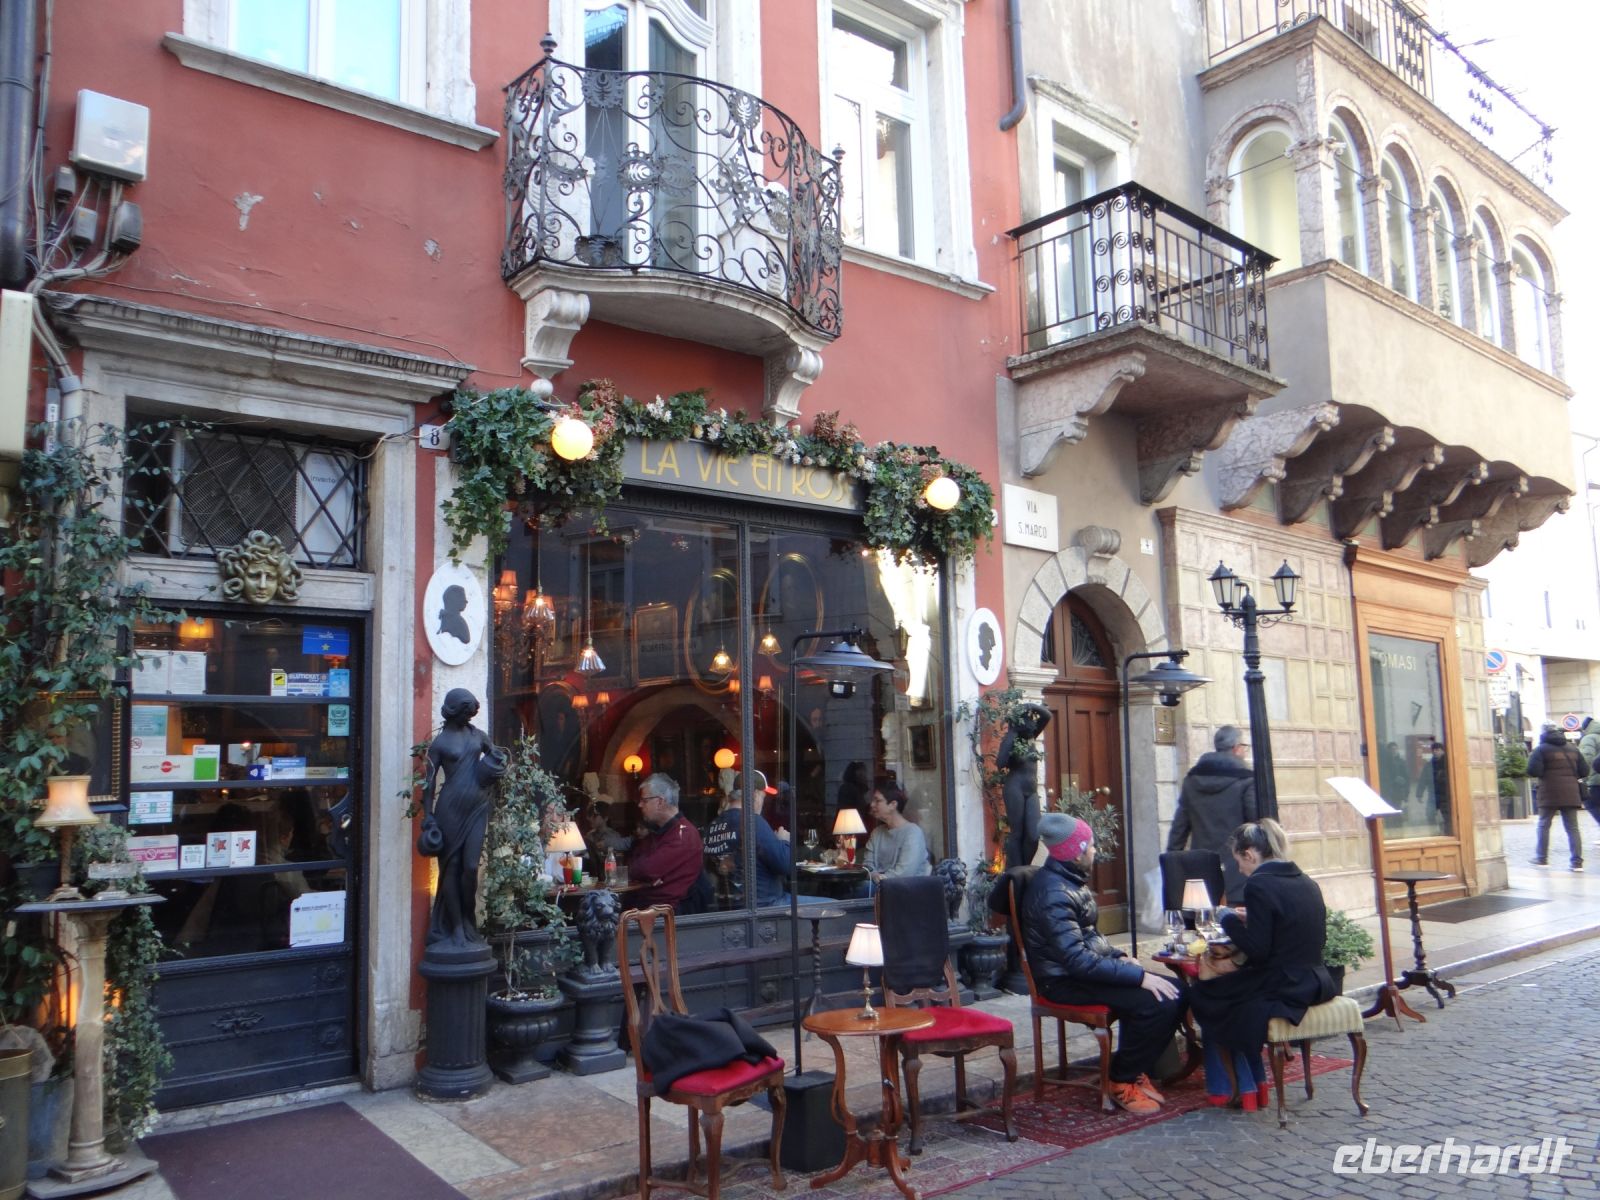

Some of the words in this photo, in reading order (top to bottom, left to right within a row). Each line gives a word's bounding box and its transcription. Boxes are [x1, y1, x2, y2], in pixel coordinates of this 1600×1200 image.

[431, 427, 440, 446] 8
[641, 438, 681, 478] LA
[1026, 500, 1038, 513] VIA
[1017, 521, 1048, 539] S.MARCO
[709, 832, 737, 844] MACHINA
